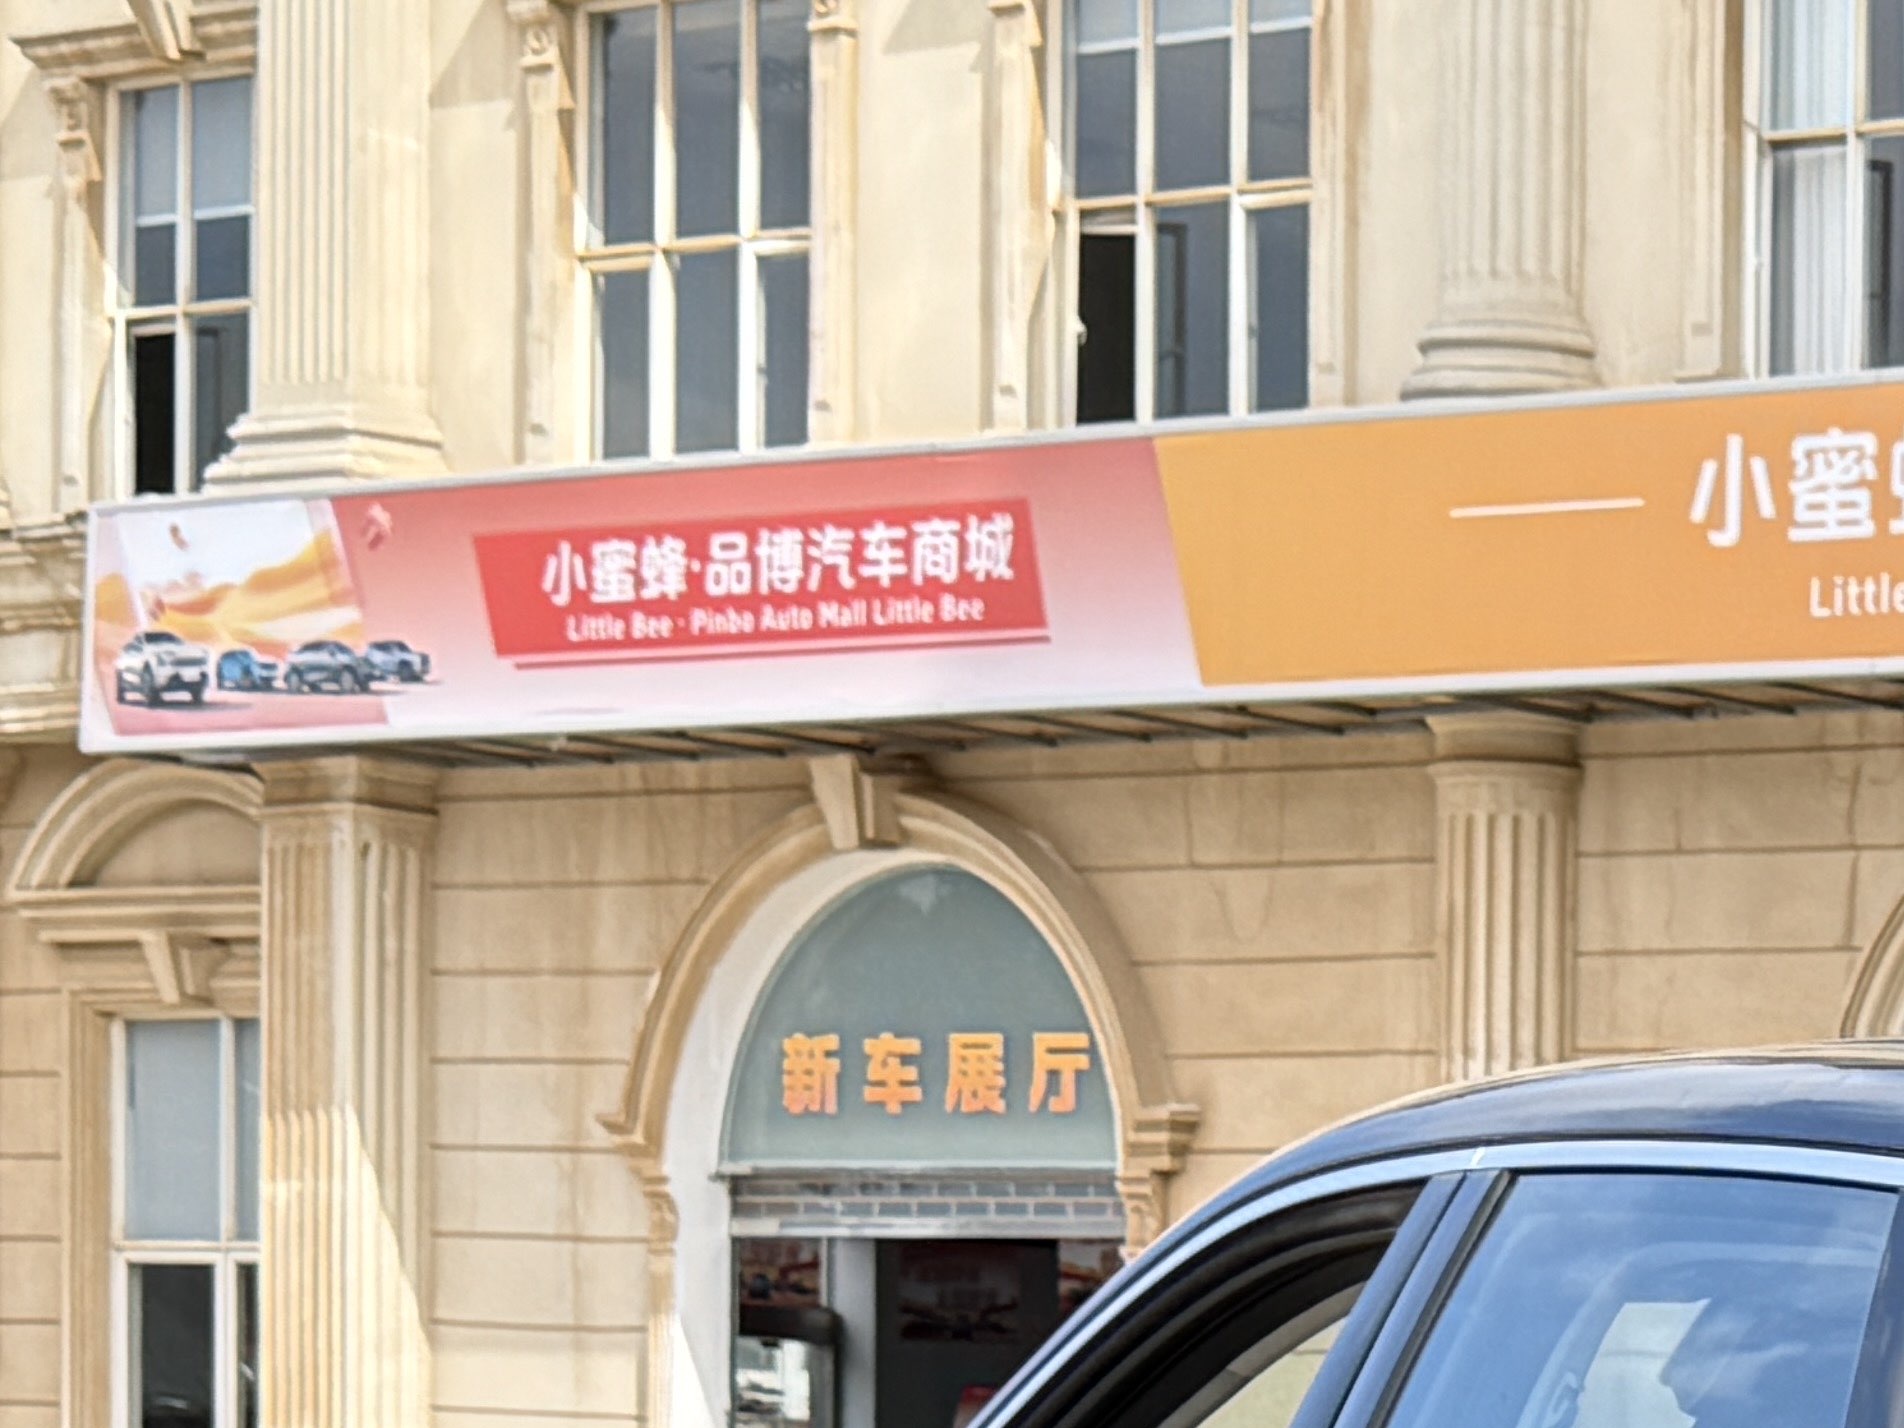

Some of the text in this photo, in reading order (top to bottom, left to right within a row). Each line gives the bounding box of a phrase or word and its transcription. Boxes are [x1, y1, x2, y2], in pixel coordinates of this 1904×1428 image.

[541, 512, 1015, 606] 小蜜蜂·品博汽车商城
[565, 592, 986, 642] Little Bee Pinbo Auto Mall Little Bee
[782, 1031, 1090, 1115] 新车展厅
